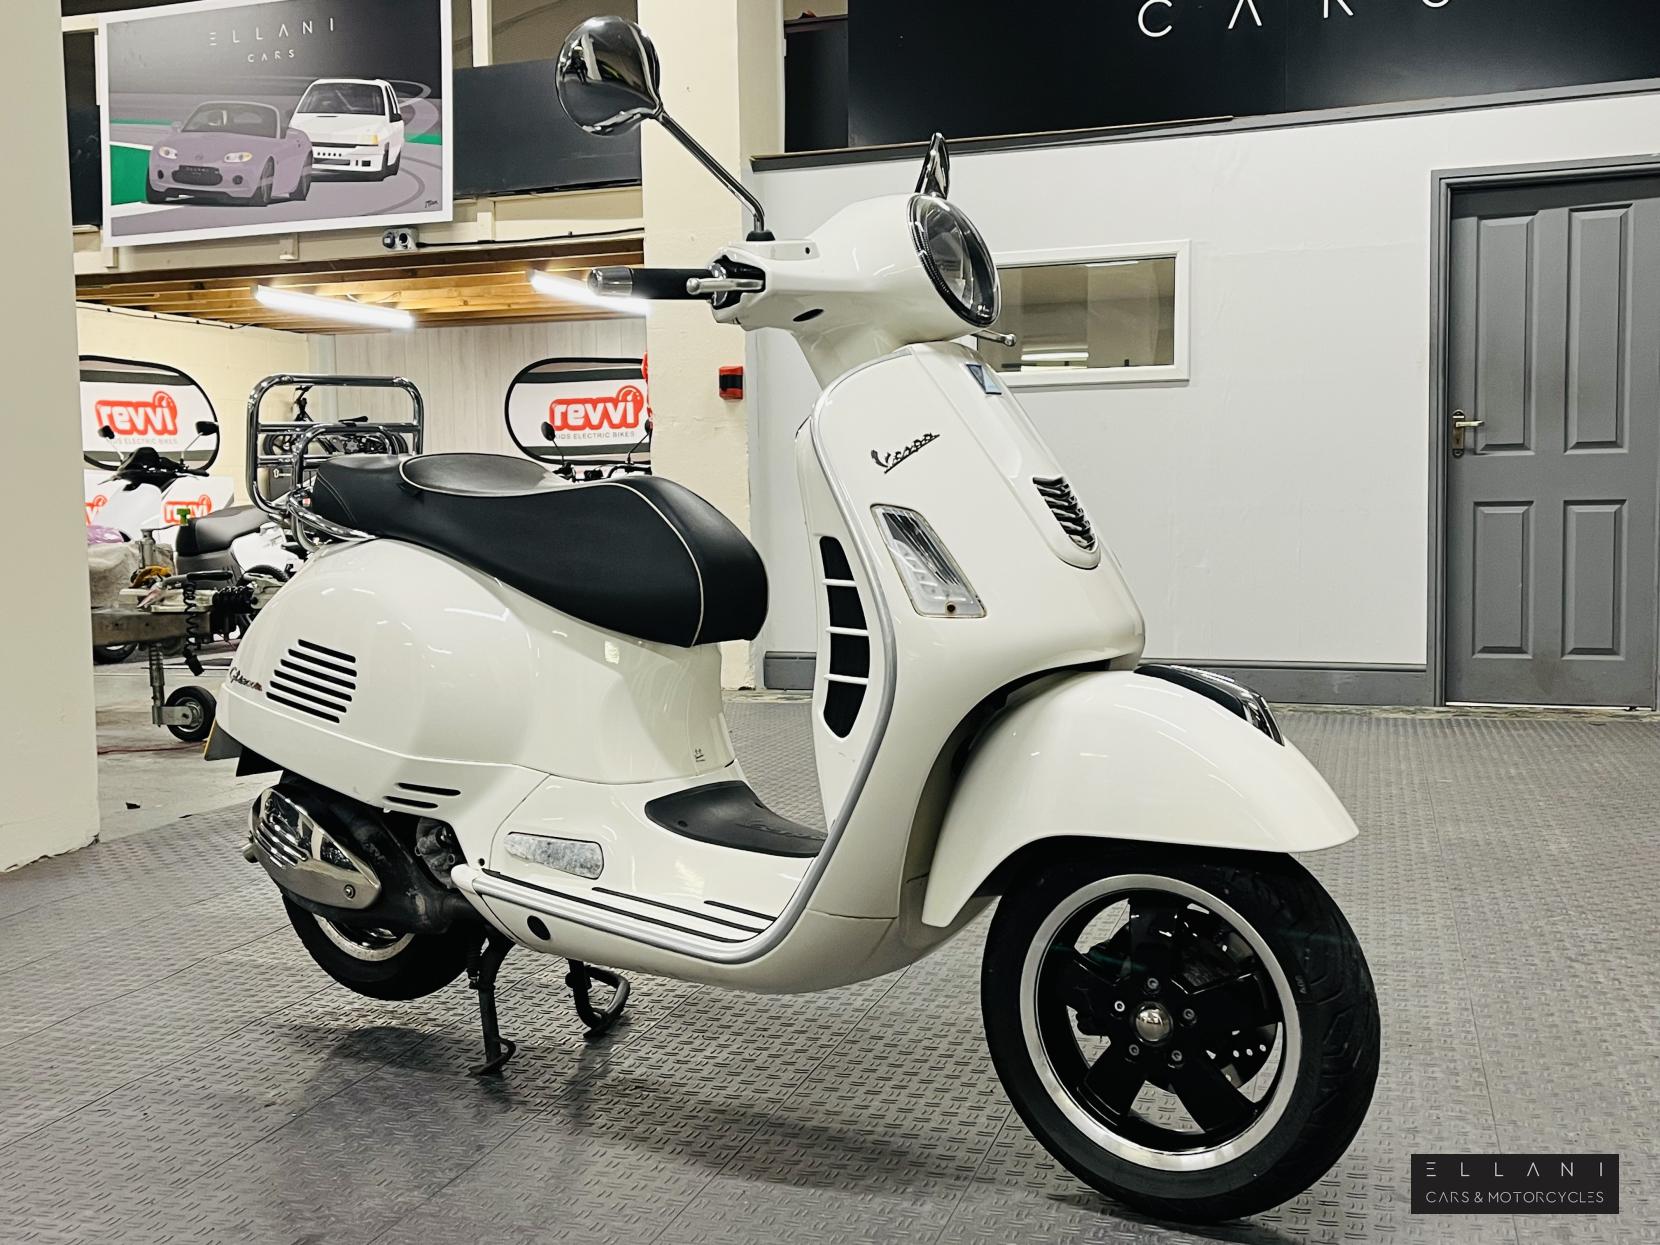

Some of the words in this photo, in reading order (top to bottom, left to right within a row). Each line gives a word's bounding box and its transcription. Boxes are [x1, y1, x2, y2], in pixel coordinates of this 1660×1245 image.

[208, 17, 335, 47] ELLANI
[1137, 0, 1449, 38] CA
[247, 49, 295, 63] CARS
[96, 392, 177, 435] revvi
[552, 388, 639, 430] revvi
[573, 432, 610, 440] ELECTRIC
[612, 430, 635, 439] BIKES
[871, 431, 941, 474] Vespa
